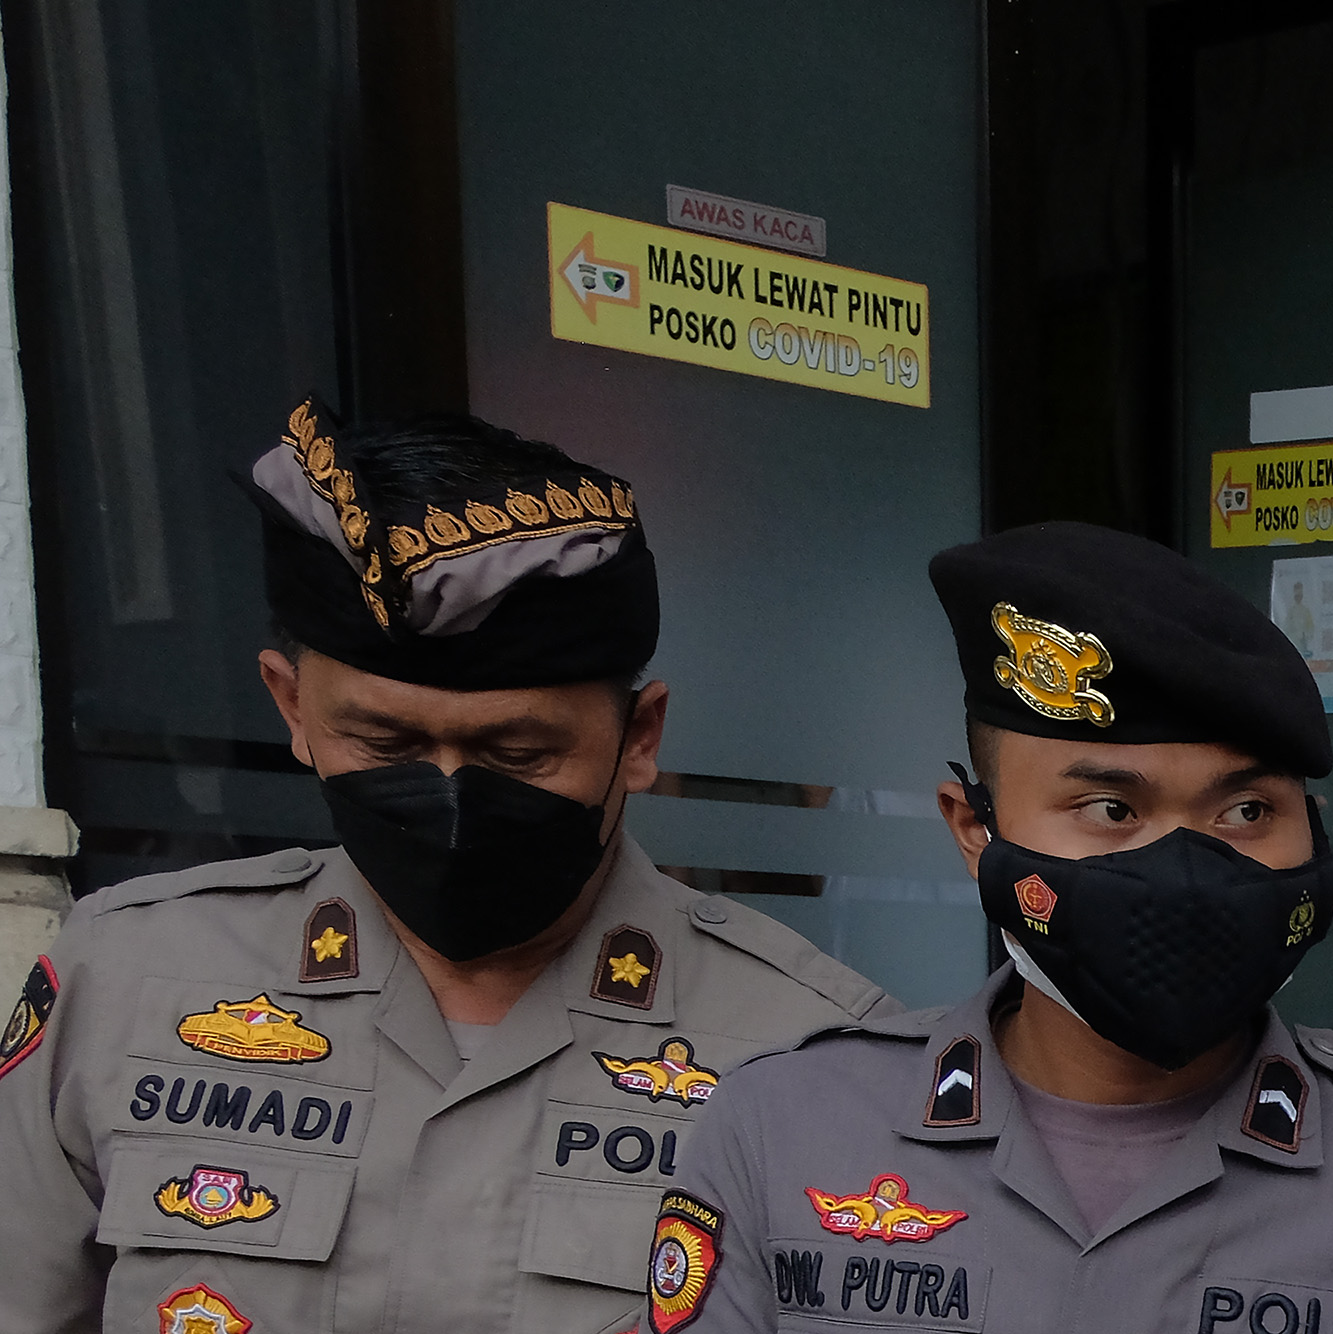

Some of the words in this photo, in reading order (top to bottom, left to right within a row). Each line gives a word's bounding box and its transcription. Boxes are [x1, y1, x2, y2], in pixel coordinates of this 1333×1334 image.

[680, 197, 746, 230] AWAS
[753, 213, 815, 246] KACA
[648, 244, 745, 300] MASUK
[754, 267, 838, 319] LEWAT
[847, 287, 921, 336] PINTU
[649, 303, 737, 350] POSKO
[749, 317, 919, 388] COVID-19
[1256, 460, 1304, 490] MASUK
[1255, 505, 1299, 531] POSKO
[1023, 917, 1049, 935] TNI
[130, 1074, 352, 1144] SUMADI
[555, 1121, 677, 1176] POL
[842, 1257, 969, 1320] PUTRA
